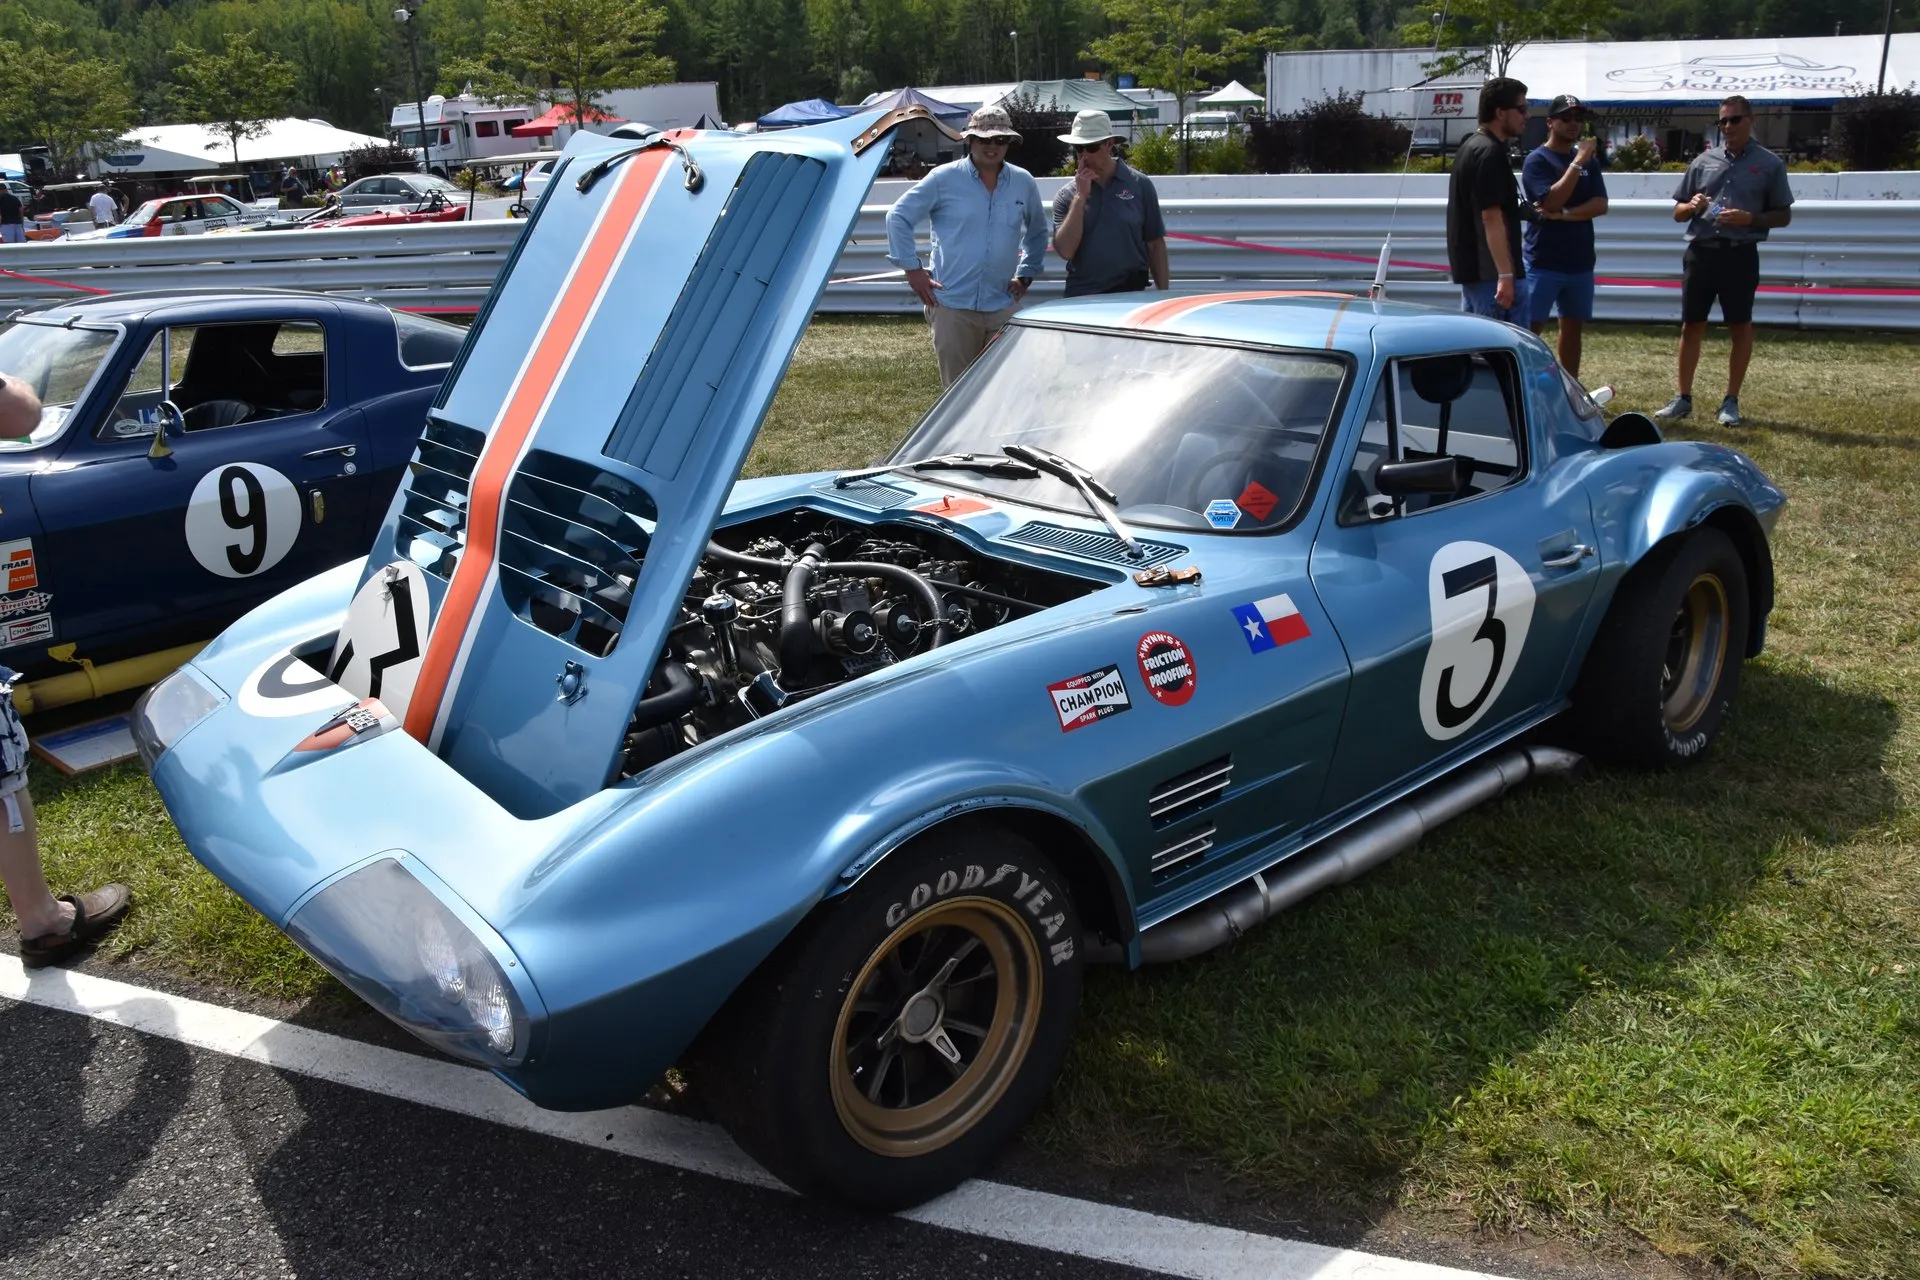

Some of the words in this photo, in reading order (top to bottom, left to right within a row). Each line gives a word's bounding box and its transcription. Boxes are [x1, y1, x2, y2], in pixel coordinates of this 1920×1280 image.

[1659, 78, 1854, 92] Motorsports
[1714, 74, 1847, 84] Donovan
[1433, 93, 1464, 105] KTR
[1431, 105, 1464, 116] Racing
[219, 465, 267, 575] 9
[1, 559, 29, 571] FRAM
[11, 574, 35, 582] FILTERS
[0, 599, 39, 611] Firestone
[12, 623, 48, 636] CHAMPION
[1140, 633, 1174, 653] WYNN'S
[1436, 555, 1506, 728] 3
[1142, 647, 1186, 671] FRICTION
[1066, 674, 1092, 689] EQUIPPED
[1091, 671, 1105, 681] WITH
[1148, 663, 1193, 688] PROOFING
[1059, 680, 1124, 714] CHAMPION
[1079, 711, 1097, 723] SPARK
[1097, 705, 1115, 717] PLUGS
[885, 863, 1074, 966] GOODYEAR
